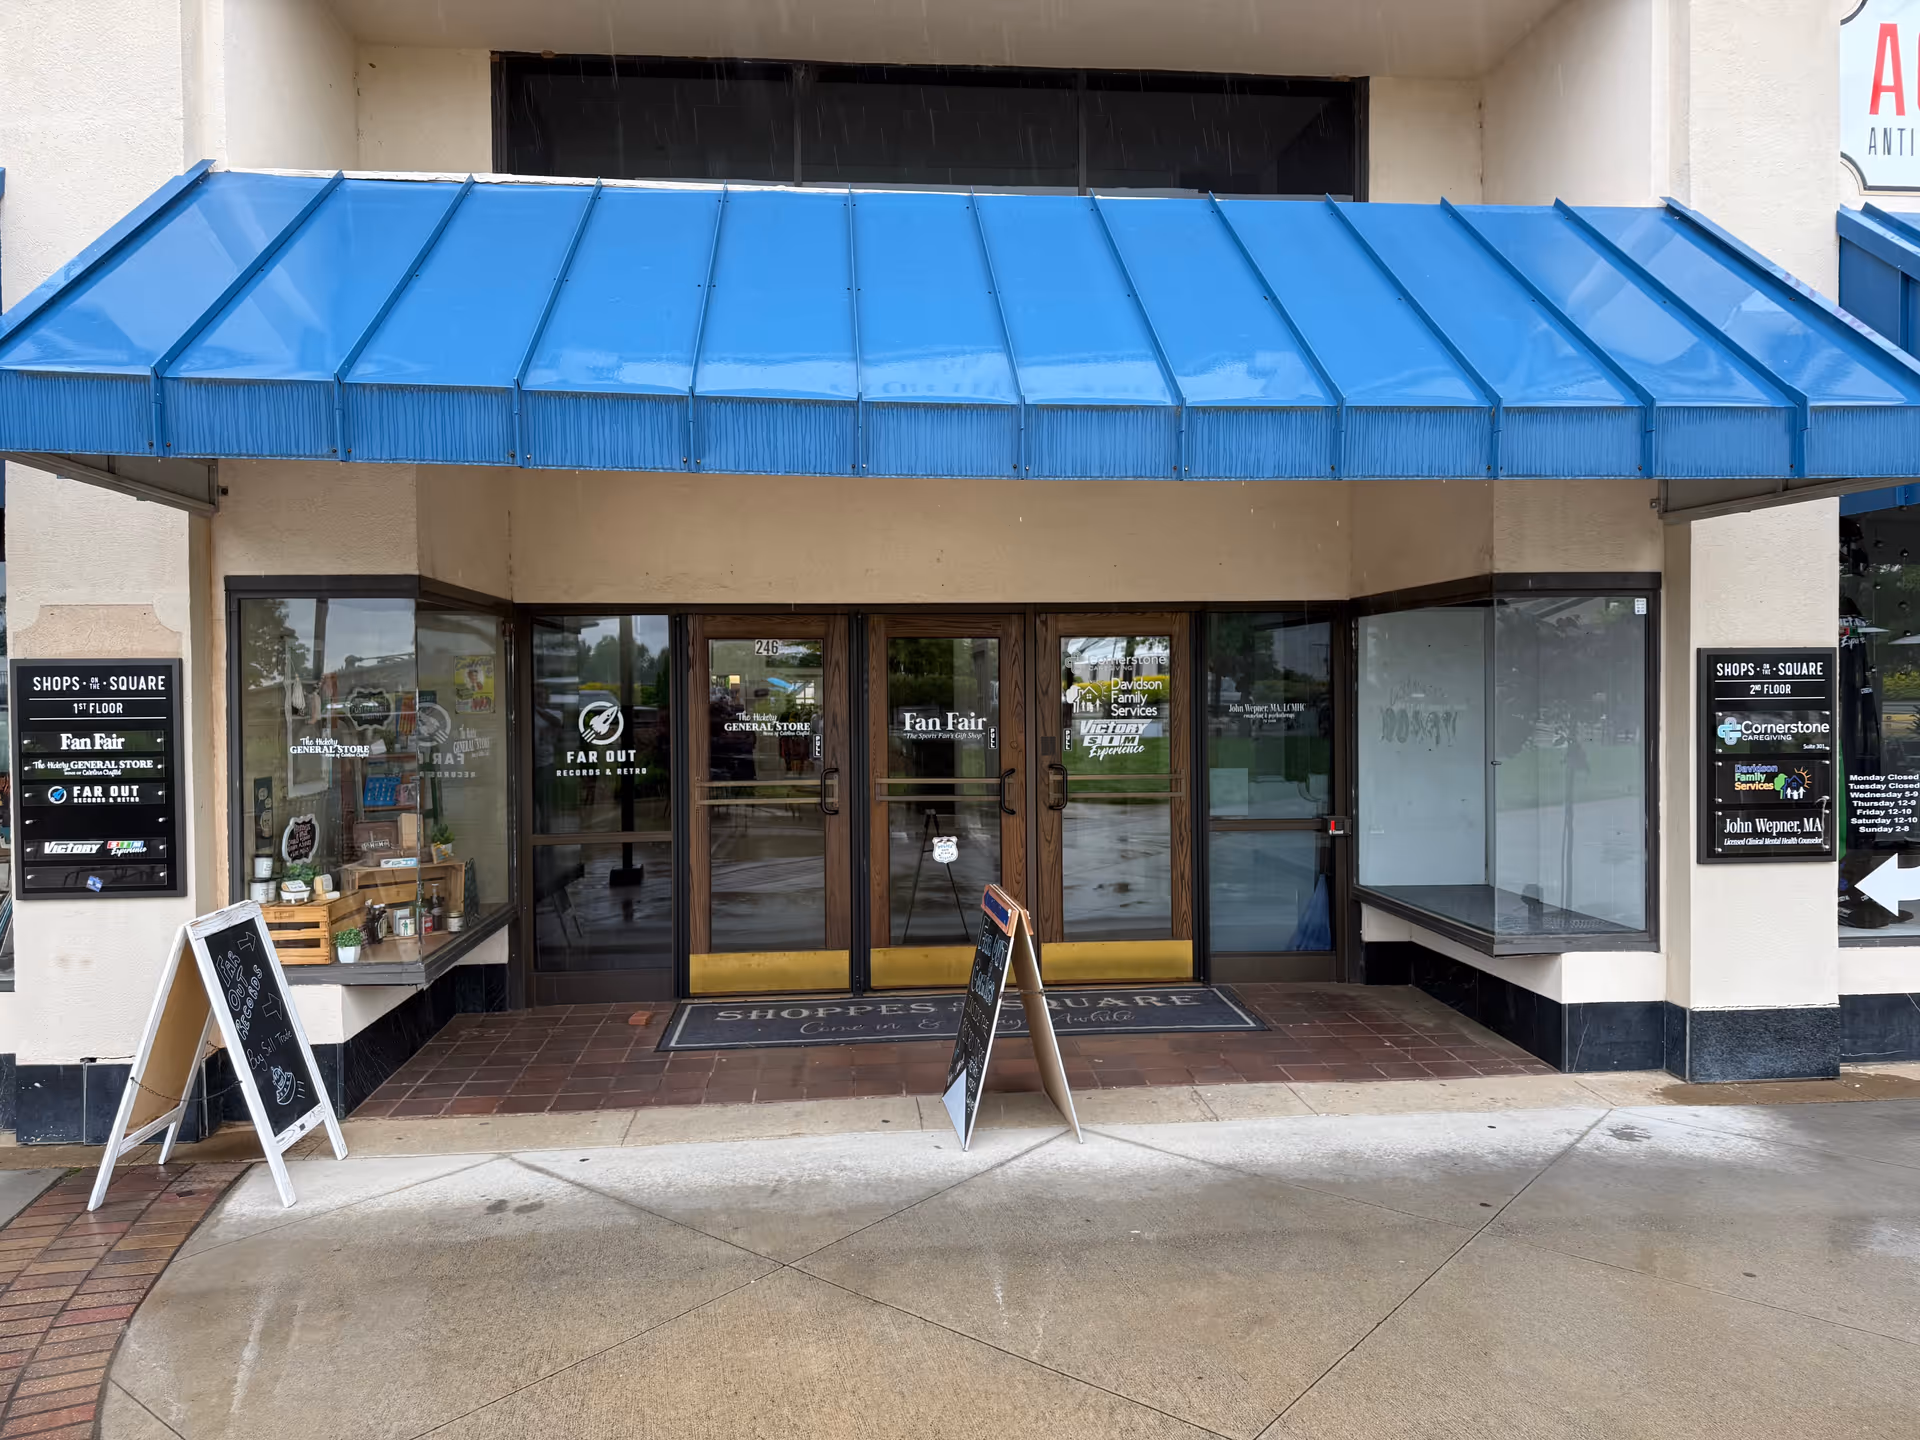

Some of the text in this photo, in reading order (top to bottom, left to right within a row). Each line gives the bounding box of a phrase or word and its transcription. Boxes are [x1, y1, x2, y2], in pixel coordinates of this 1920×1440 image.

[1868, 22, 1920, 116] A
[755, 640, 779, 655] 246
[1716, 662, 1755, 676] SHOPS
[1778, 661, 1824, 676] SQUARE
[33, 675, 80, 691] SHOPS
[90, 676, 99, 684] ON
[109, 675, 166, 691] SQUARE
[1111, 678, 1162, 690] Davidson
[1749, 683, 1792, 694] 2ND FLOOR
[1111, 691, 1148, 706] Family
[73, 702, 123, 714] 1ST FLOOR
[1111, 704, 1158, 716] Services
[1228, 703, 1244, 713] John
[736, 710, 751, 721] The
[903, 711, 987, 731] Fan Fair
[724, 722, 810, 732] GENERAL STORE
[1741, 719, 1830, 735] Cornerstone
[60, 733, 125, 750] Fan Fair
[300, 735, 314, 746] The
[918, 732, 937, 740] Sports
[955, 732, 967, 740] Gift
[1086, 736, 1137, 745] SIM
[290, 745, 370, 754] GENERAL STORE
[1088, 744, 1146, 761] Experience
[566, 750, 637, 764] FAR OUT
[32, 759, 45, 769] The
[70, 760, 118, 769] GENERAL
[118, 759, 153, 768] STORE
[1734, 764, 1778, 773] Davidson
[556, 767, 647, 777] RECORDS & RETRO
[1734, 773, 1766, 783] Family
[1849, 773, 1920, 782] Monday Closed
[73, 785, 140, 797] FAR OUT
[1734, 781, 1774, 791] Services
[1848, 782, 1920, 791] Tuesday Closed
[1850, 790, 1919, 799] Wednesday 5-9
[1852, 800, 1896, 808] Thursday
[1856, 808, 1887, 817] Friday
[1850, 816, 1918, 825] Saturday 12-10
[1724, 817, 1823, 837] John Wepner, MA
[1858, 825, 1910, 834] Sunday 2-8
[1723, 836, 1823, 846] Licensed Clinical Mental Health Counselor
[110, 845, 148, 857] Experience
[216, 950, 241, 988] FAR
[228, 965, 249, 1012] OUT
[235, 964, 263, 1041] RECORDS
[715, 1001, 936, 1021] SHOPPES
[799, 1020, 862, 1035] Come
[876, 1022, 901, 1031] in
[246, 1029, 293, 1072] Buy Sell Trade
